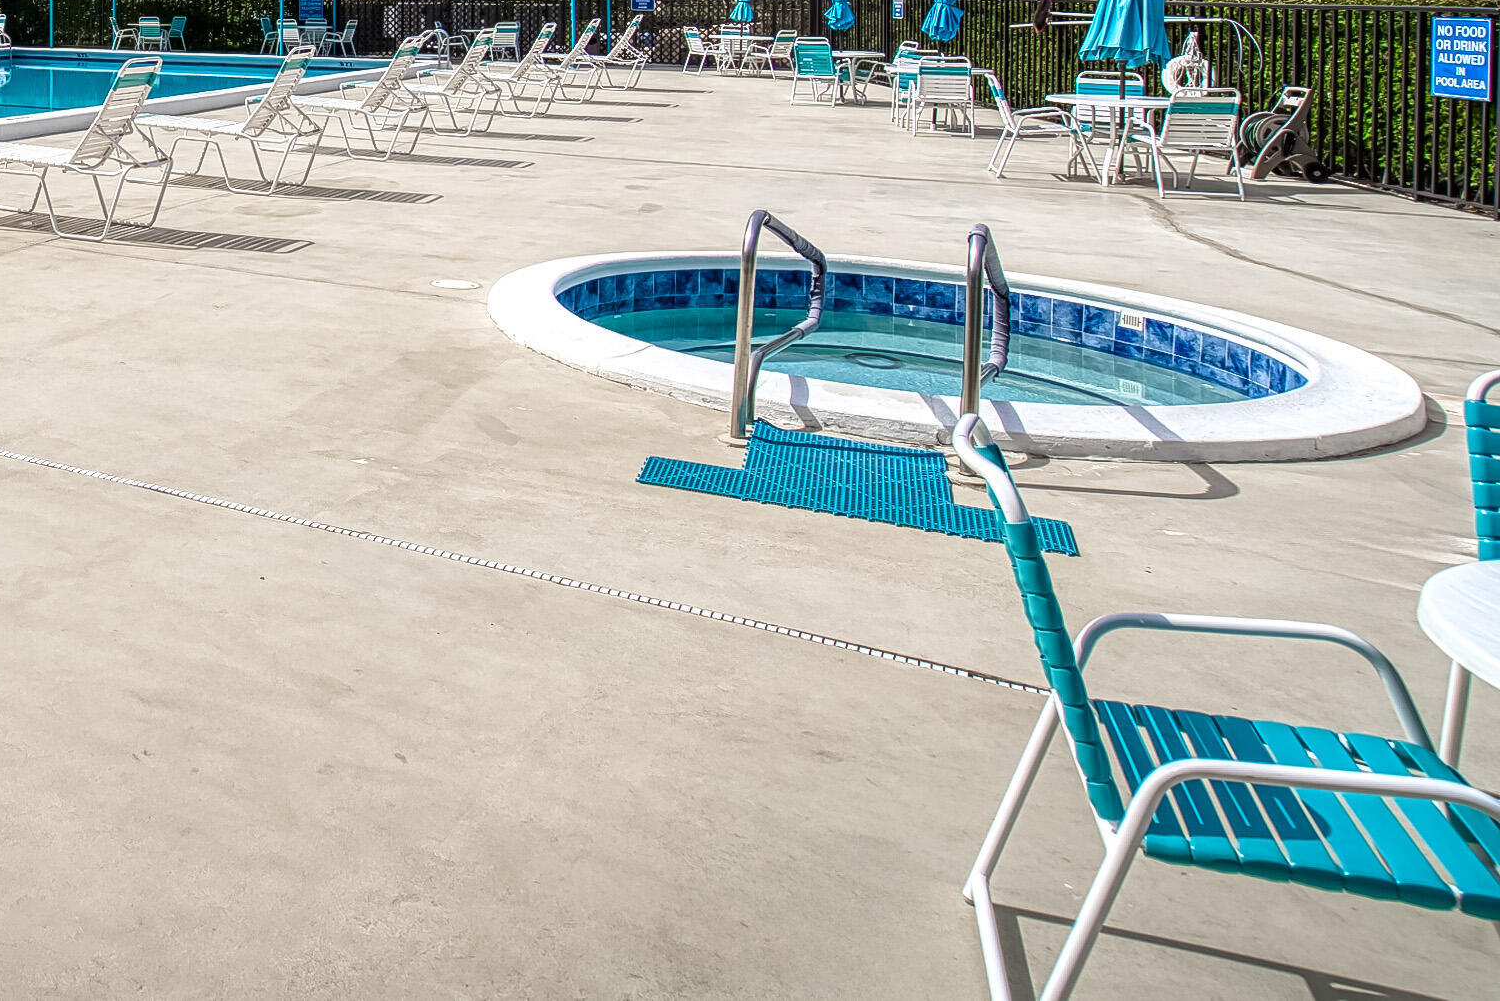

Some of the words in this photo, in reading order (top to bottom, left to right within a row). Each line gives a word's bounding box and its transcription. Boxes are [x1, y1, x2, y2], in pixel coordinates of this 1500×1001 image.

[1437, 25, 1453, 37] NO
[1456, 26, 1486, 38] FOOD
[1436, 39, 1451, 50] OR
[1454, 40, 1487, 52] DRINK
[1438, 53, 1485, 65] ALLOWED
[1456, 67, 1466, 76] IN
[1436, 77, 1460, 87] POOL
[1461, 79, 1486, 90] AREA
